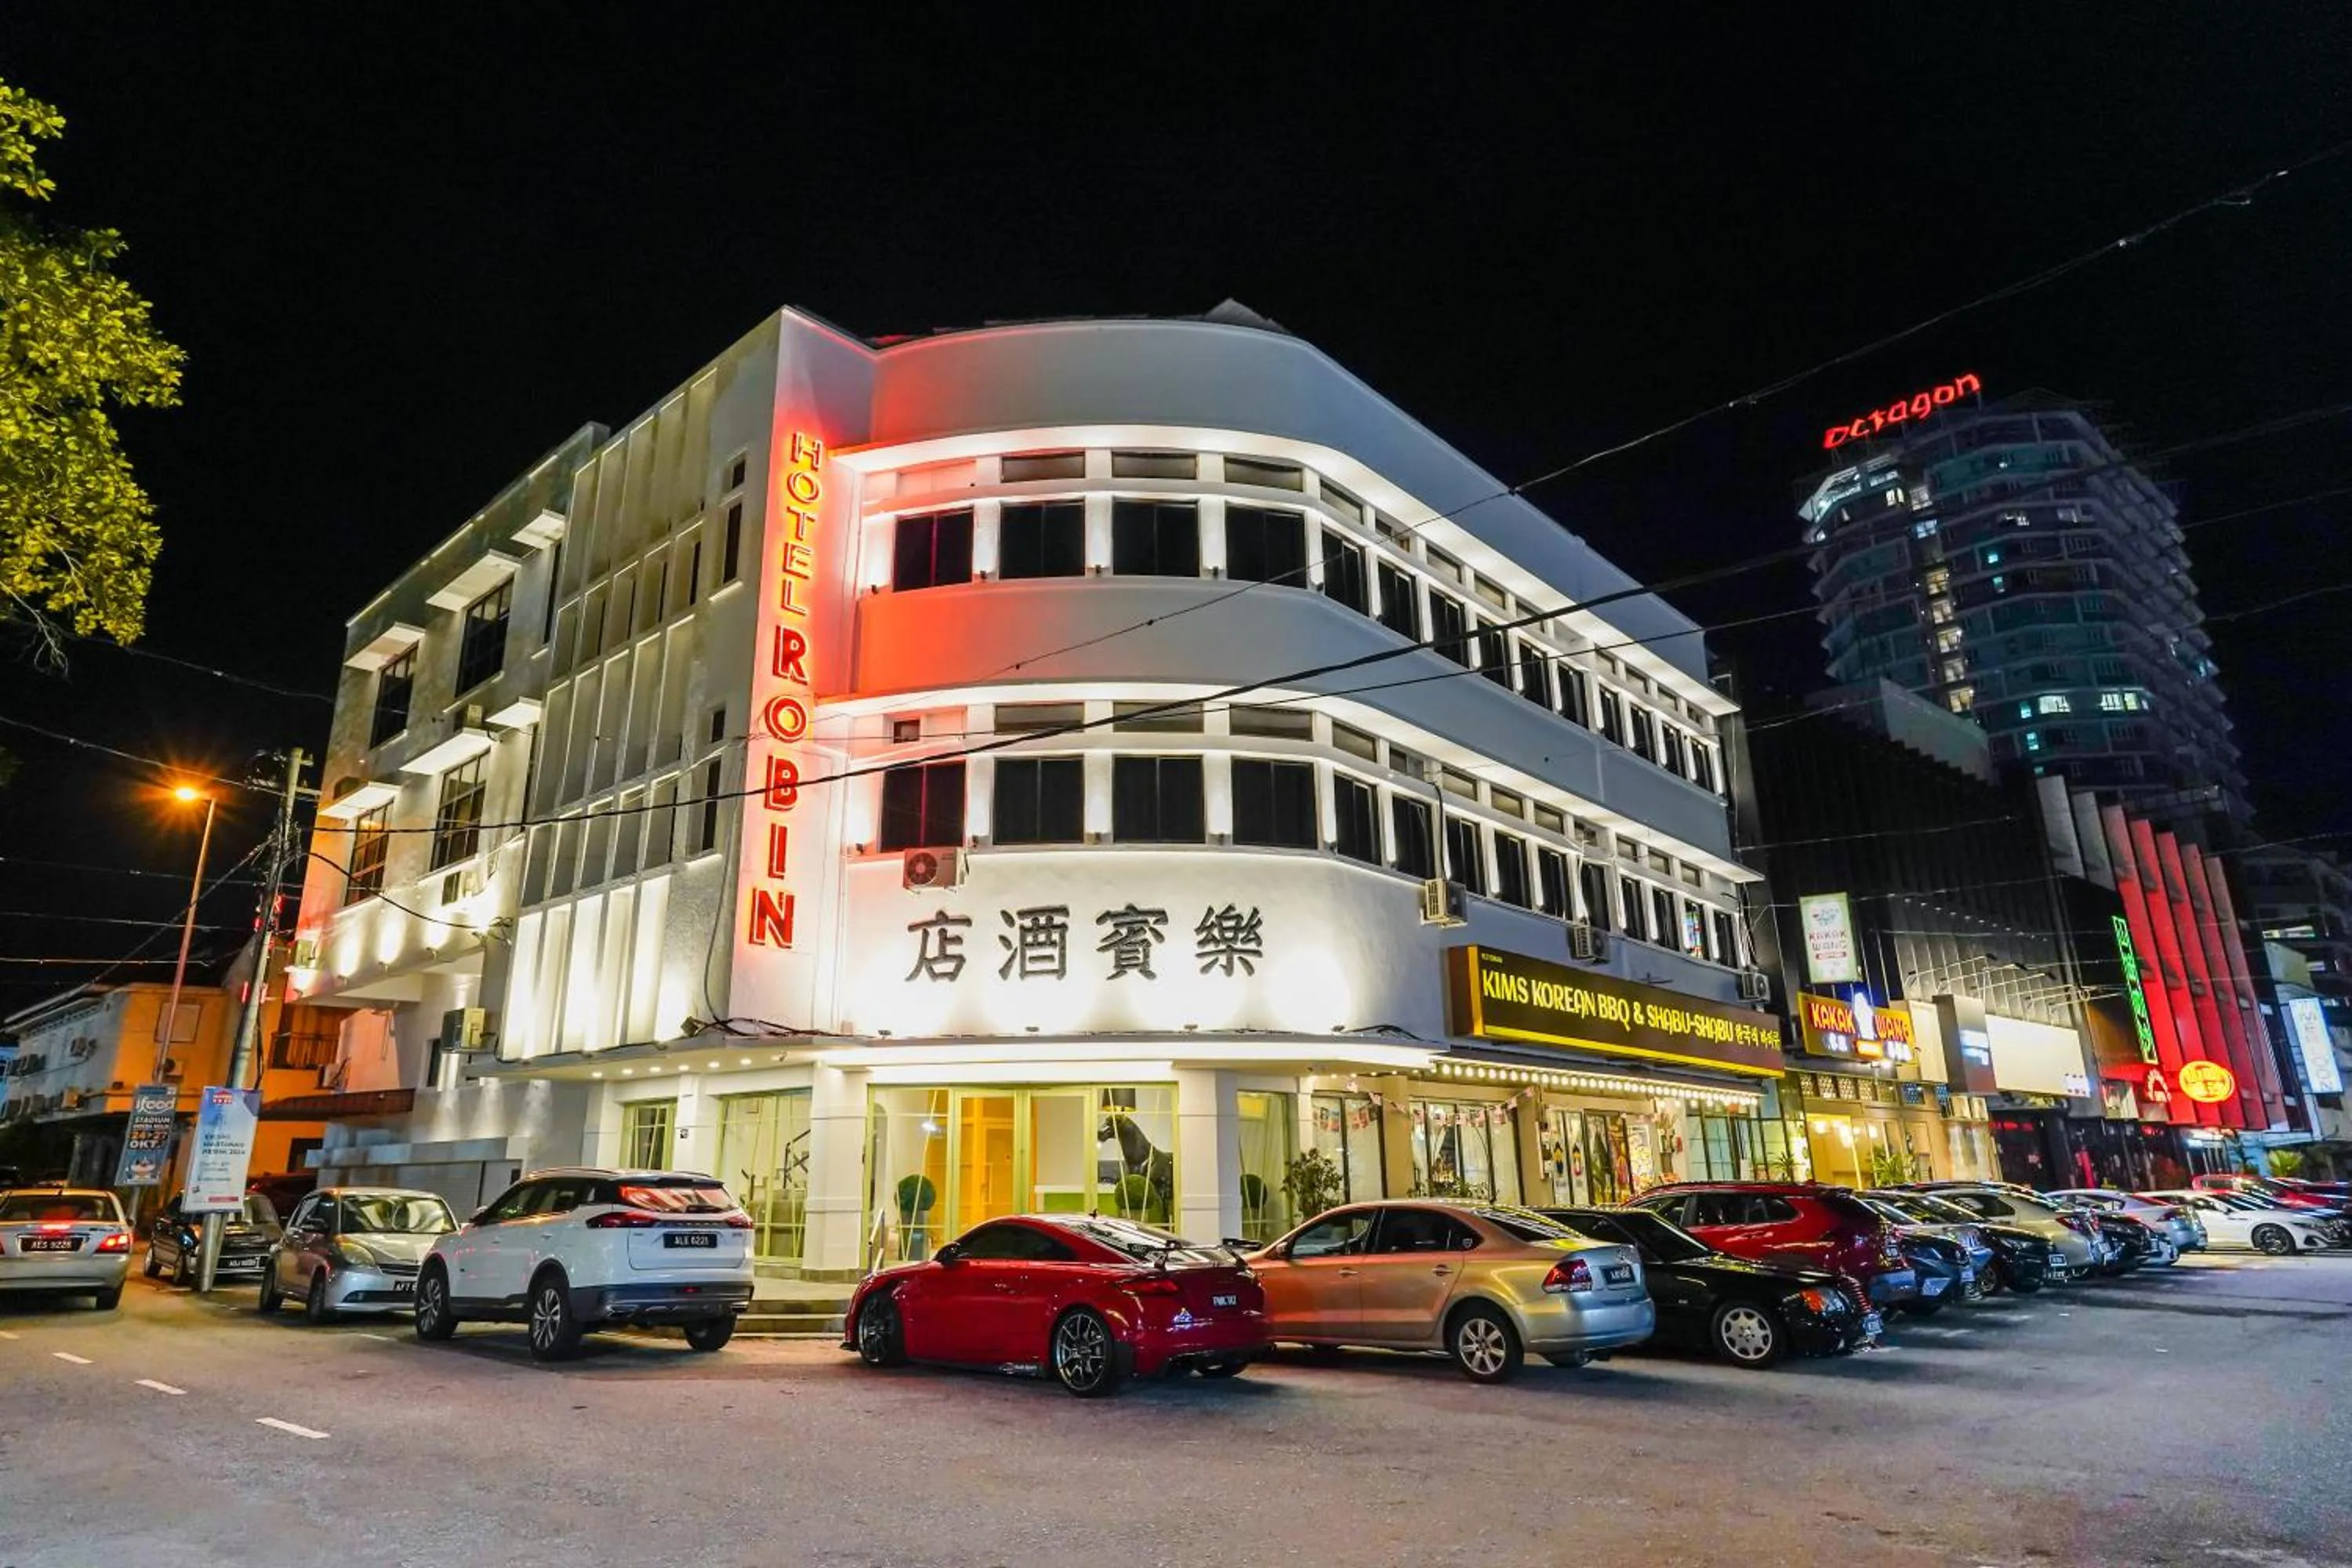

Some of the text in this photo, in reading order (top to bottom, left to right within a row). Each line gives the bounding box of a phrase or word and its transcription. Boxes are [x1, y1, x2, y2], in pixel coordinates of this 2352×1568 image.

[1823, 373, 1980, 449] octagon
[748, 431, 824, 949] HOTEL ROBIN
[1808, 929, 1848, 941] KAKAK
[1812, 941, 1848, 951] WANG
[1482, 968, 1733, 1044] KIMS KOREAN BBQ & SHABU-SHABU
[1810, 1003, 1857, 1034] KAKAK
[1875, 1014, 1911, 1044] WANG
